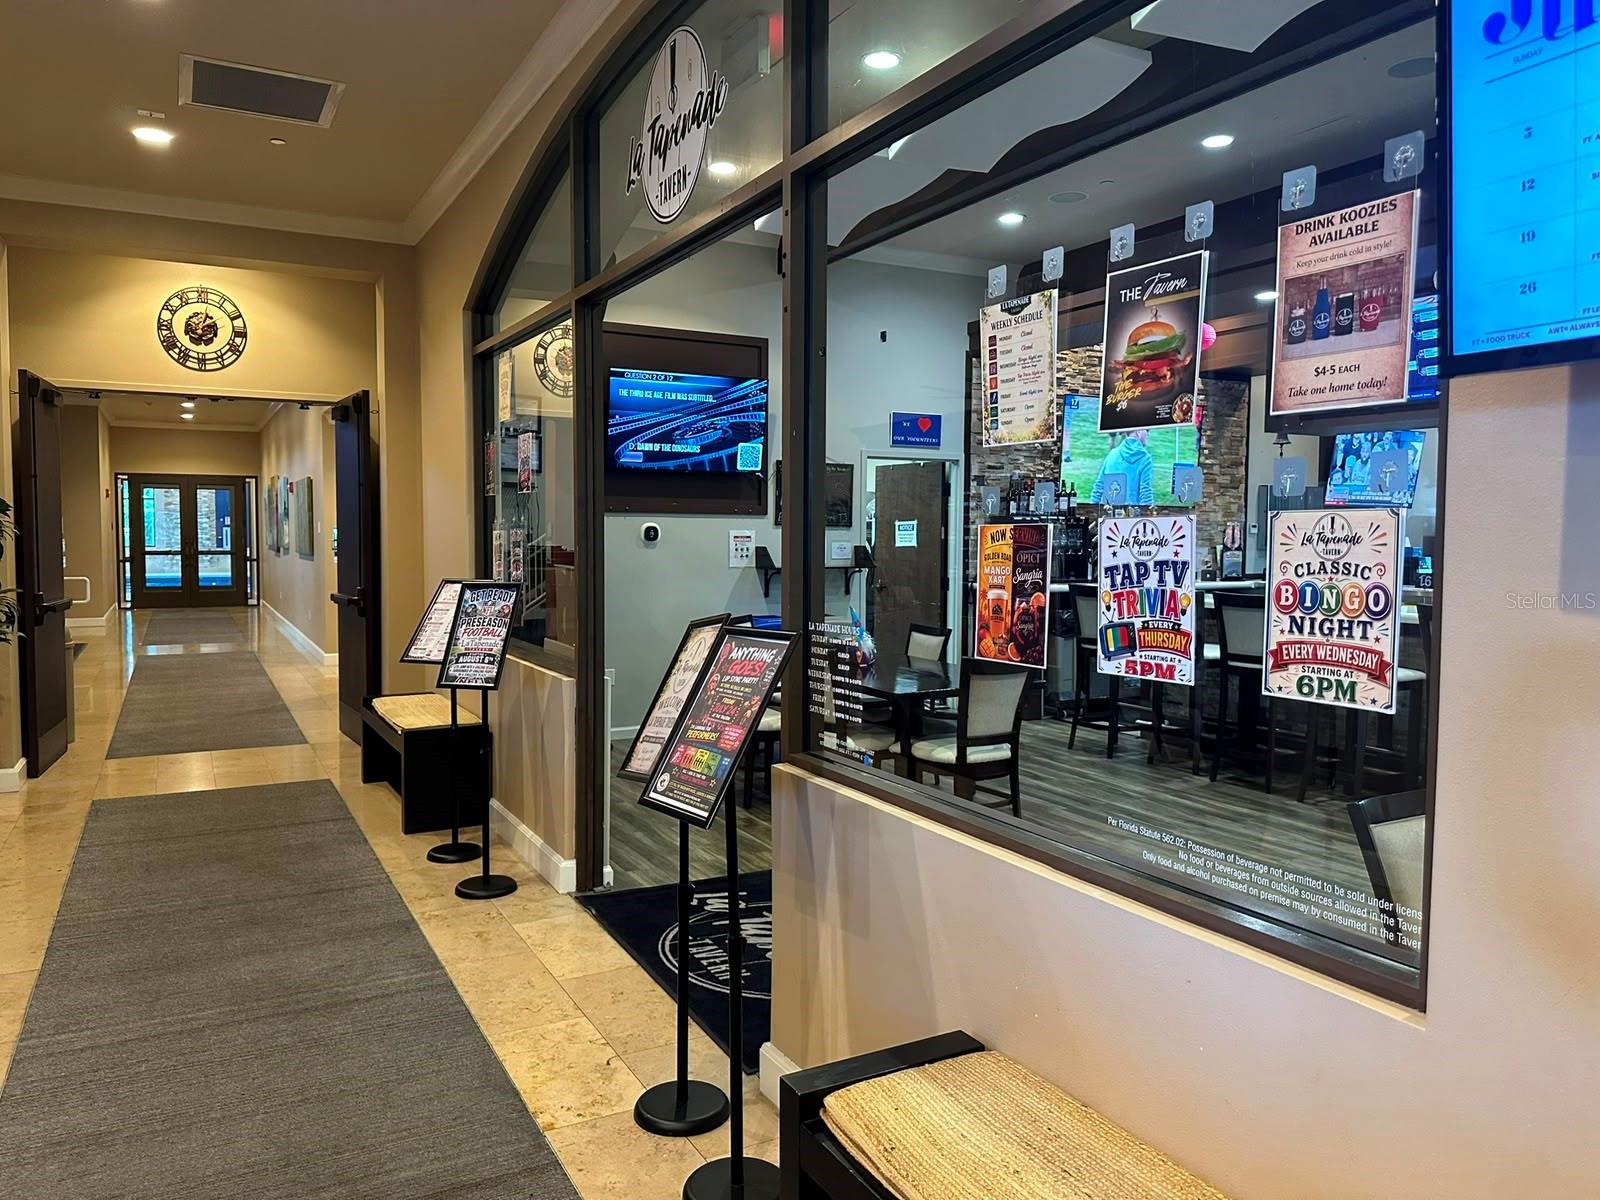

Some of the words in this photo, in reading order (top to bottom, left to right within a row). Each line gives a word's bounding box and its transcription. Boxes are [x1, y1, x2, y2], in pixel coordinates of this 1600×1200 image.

[1512, 47, 1543, 65] SUNDAY
[626, 136, 646, 195] La
[647, 70, 729, 177] Tapenade
[1524, 126, 1533, 139] 5
[1520, 178, 1535, 192] 12
[1295, 214, 1335, 236] DRINK
[1339, 198, 1398, 224] KOOZIES
[1308, 219, 1379, 248] AVAILABLE
[1520, 230, 1536, 244] 19
[1295, 258, 1313, 271] Keep
[1313, 254, 1329, 268] your
[1329, 249, 1348, 262] drink
[1348, 246, 1364, 257] cold
[1364, 245, 1372, 254] in
[1372, 239, 1393, 253] style!
[1120, 286, 1142, 302] THE
[1143, 273, 1188, 301] Tavern
[1519, 281, 1537, 295] 26
[990, 317, 1012, 331] WEEKLY
[1013, 309, 1043, 326] SCHEDULE
[1486, 335, 1506, 345] FOOD
[1506, 331, 1531, 341] TRUCK
[624, 371, 652, 382] QUESTION
[657, 374, 665, 382] OF
[1338, 363, 1361, 374] EACH
[618, 388, 629, 397] THE
[629, 389, 644, 398] THIRD
[644, 390, 653, 399] ICE
[653, 390, 664, 399] AGE
[664, 391, 677, 400] FILM
[676, 392, 687, 401] WAS
[1114, 378, 1133, 394] THE
[1287, 386, 1309, 399] Take
[1310, 385, 1327, 396] one
[1328, 380, 1354, 393] home
[1356, 375, 1388, 393] today!
[1105, 386, 1143, 406] BURGER
[637, 442, 653, 452] DAWN
[654, 444, 661, 452] OF
[661, 444, 672, 452] THE
[672, 444, 701, 454] DINOSAURS
[989, 528, 1006, 545] NOW
[1119, 535, 1131, 548] La
[1132, 535, 1170, 551] Tapenade
[1300, 532, 1315, 546] La
[1315, 531, 1364, 548] Tapenade
[983, 551, 1000, 562] GOLDEN
[1000, 552, 1011, 562] ROAD
[1016, 553, 1040, 564] OPICI
[1322, 548, 1341, 556] TAVERN
[983, 566, 1011, 575] MANGO
[1012, 567, 1043, 588] Sangria
[1104, 560, 1150, 591] TAP
[1153, 560, 1189, 588] TV
[1294, 561, 1373, 581] CLASSIC
[988, 575, 1006, 584] KART
[470, 589, 488, 602] GET
[488, 588, 514, 602] READY
[1279, 583, 1387, 614] BINGO
[1111, 587, 1181, 622] TRIVIA
[460, 618, 509, 630] PRESEASON
[461, 627, 503, 638] FOOTBALL
[808, 621, 815, 630] LA
[815, 622, 841, 634] TAPENADE
[841, 625, 860, 636] HOURS
[1148, 621, 1174, 630] EVERY
[1287, 615, 1374, 641] NIGHT
[1138, 630, 1188, 652] THURSDAY
[458, 655, 484, 663] AUGUST
[728, 646, 778, 664] ANYTHING
[1143, 653, 1169, 662] STARTING
[1282, 644, 1314, 660] EVERY
[1316, 645, 1380, 670] WEDNESDAY
[727, 659, 769, 677] GOES!
[1123, 659, 1177, 681] 5PM
[1301, 664, 1342, 678] STARTING
[1342, 669, 1354, 679] AT
[1296, 674, 1358, 703] 6PM
[685, 729, 720, 741] PERFORMERS!
[1107, 816, 1118, 826] Per
[1118, 819, 1139, 834] Florida
[1139, 826, 1161, 841] Statute
[1161, 832, 1186, 849] 562.02:
[1187, 840, 1225, 861] Possession
[1226, 852, 1235, 862] of
[1236, 854, 1268, 874] beverage
[1269, 866, 1283, 878] not
[1284, 870, 1322, 890] permitted
[1323, 882, 1333, 893] to
[1334, 884, 1345, 897] be
[1346, 888, 1365, 903] sold
[1367, 894, 1394, 912] under
[1142, 850, 1157, 864] Only
[1157, 855, 1172, 868] food
[1172, 861, 1186, 873] and
[1186, 866, 1211, 881] alcohol
[1211, 873, 1248, 894] purchased
[1249, 886, 1260, 897] on
[1260, 890, 1291, 908] premise
[1292, 900, 1310, 914] may
[1310, 905, 1322, 919] by
[1322, 910, 1367, 932] consumed
[1369, 923, 1378, 935] in
[1380, 927, 1394, 941] the
[1396, 932, 1422, 950] Taver
[1178, 849, 1189, 861] No
[1189, 852, 1205, 866] food
[1205, 859, 1214, 868] or
[1214, 860, 1250, 881] beverages
[1251, 871, 1269, 887] from
[1271, 880, 1300, 897] outside
[1300, 889, 1333, 907] sources
[1334, 899, 1367, 918] allowed
[1369, 909, 1379, 921] in
[1380, 912, 1395, 926] the
[1397, 917, 1422, 935] Taver
